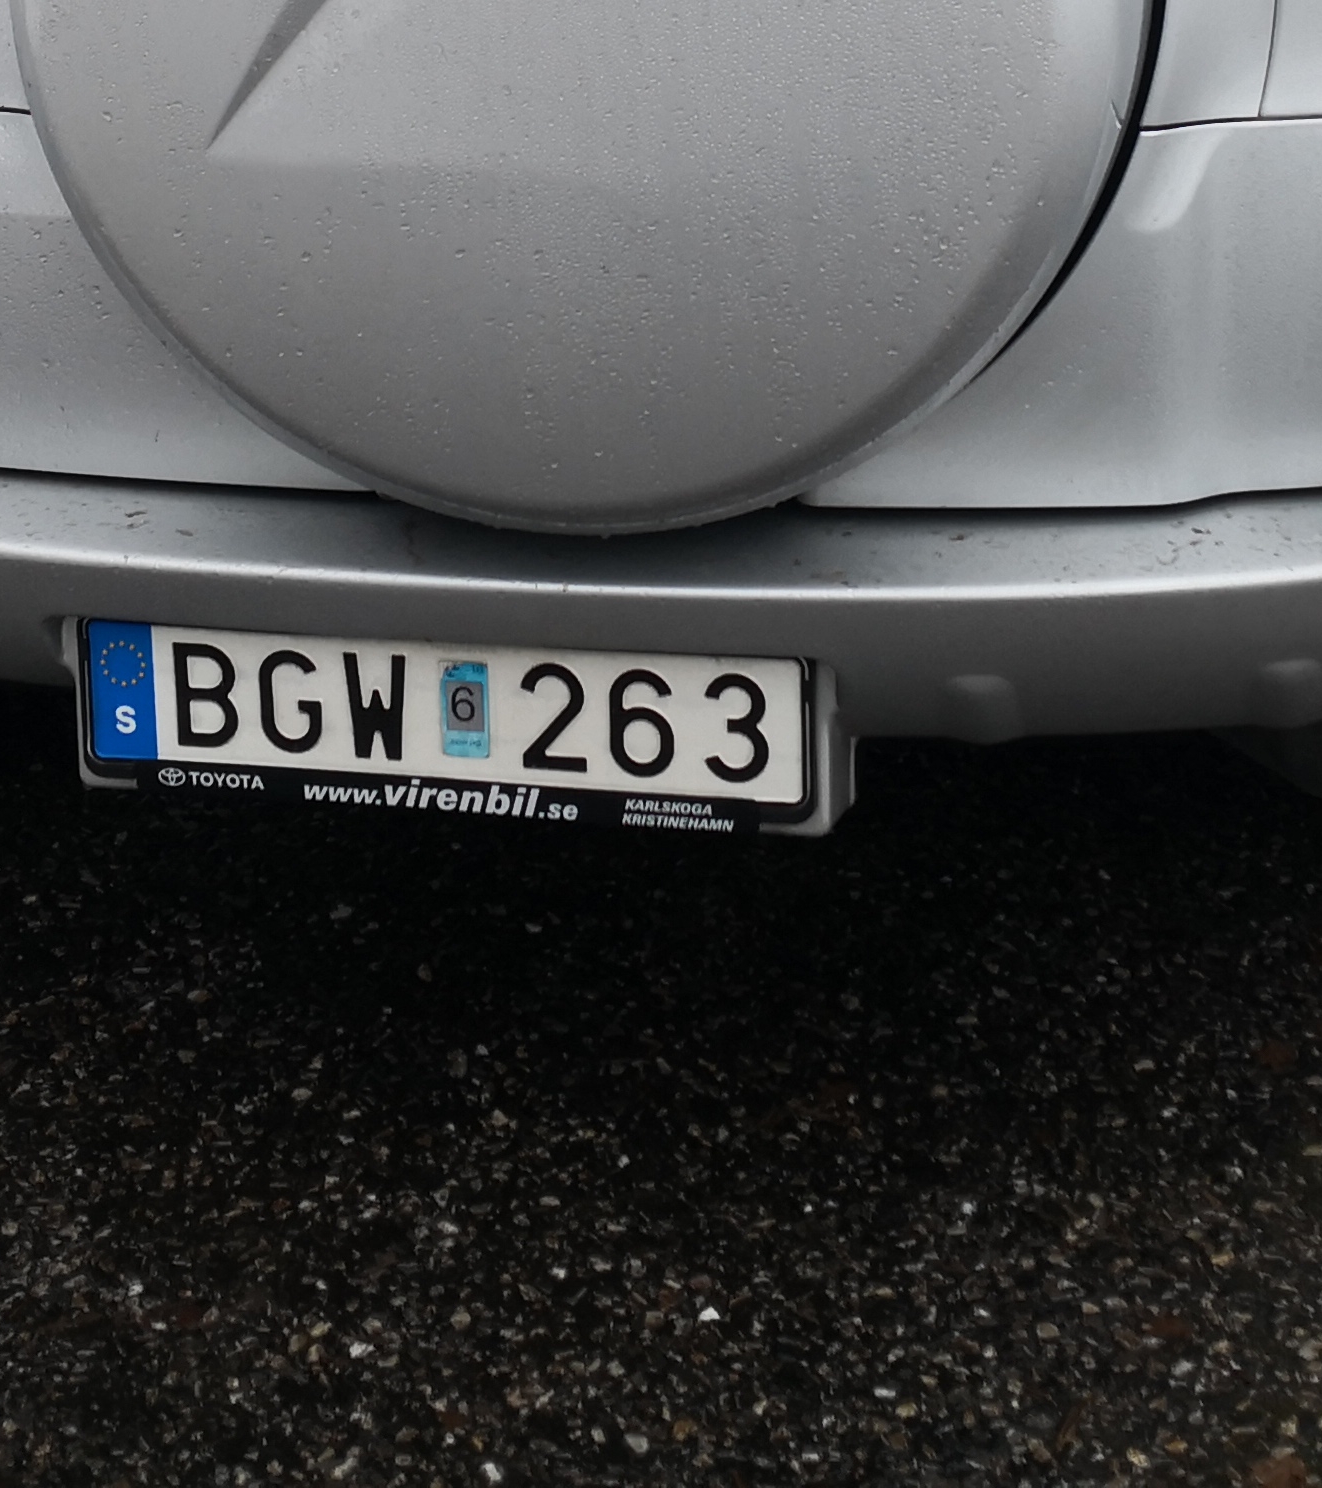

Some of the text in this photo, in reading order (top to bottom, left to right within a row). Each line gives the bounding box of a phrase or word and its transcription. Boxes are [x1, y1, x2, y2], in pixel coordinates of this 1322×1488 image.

[173, 643, 770, 783] BGW 263
[451, 686, 475, 722] 6
[115, 705, 137, 734] S
[188, 771, 265, 790] TOYOTA
[303, 779, 579, 821] www.virenbil.se
[624, 798, 713, 817] KARLSKOGA
[622, 812, 735, 833] KRISTINEHAMN
